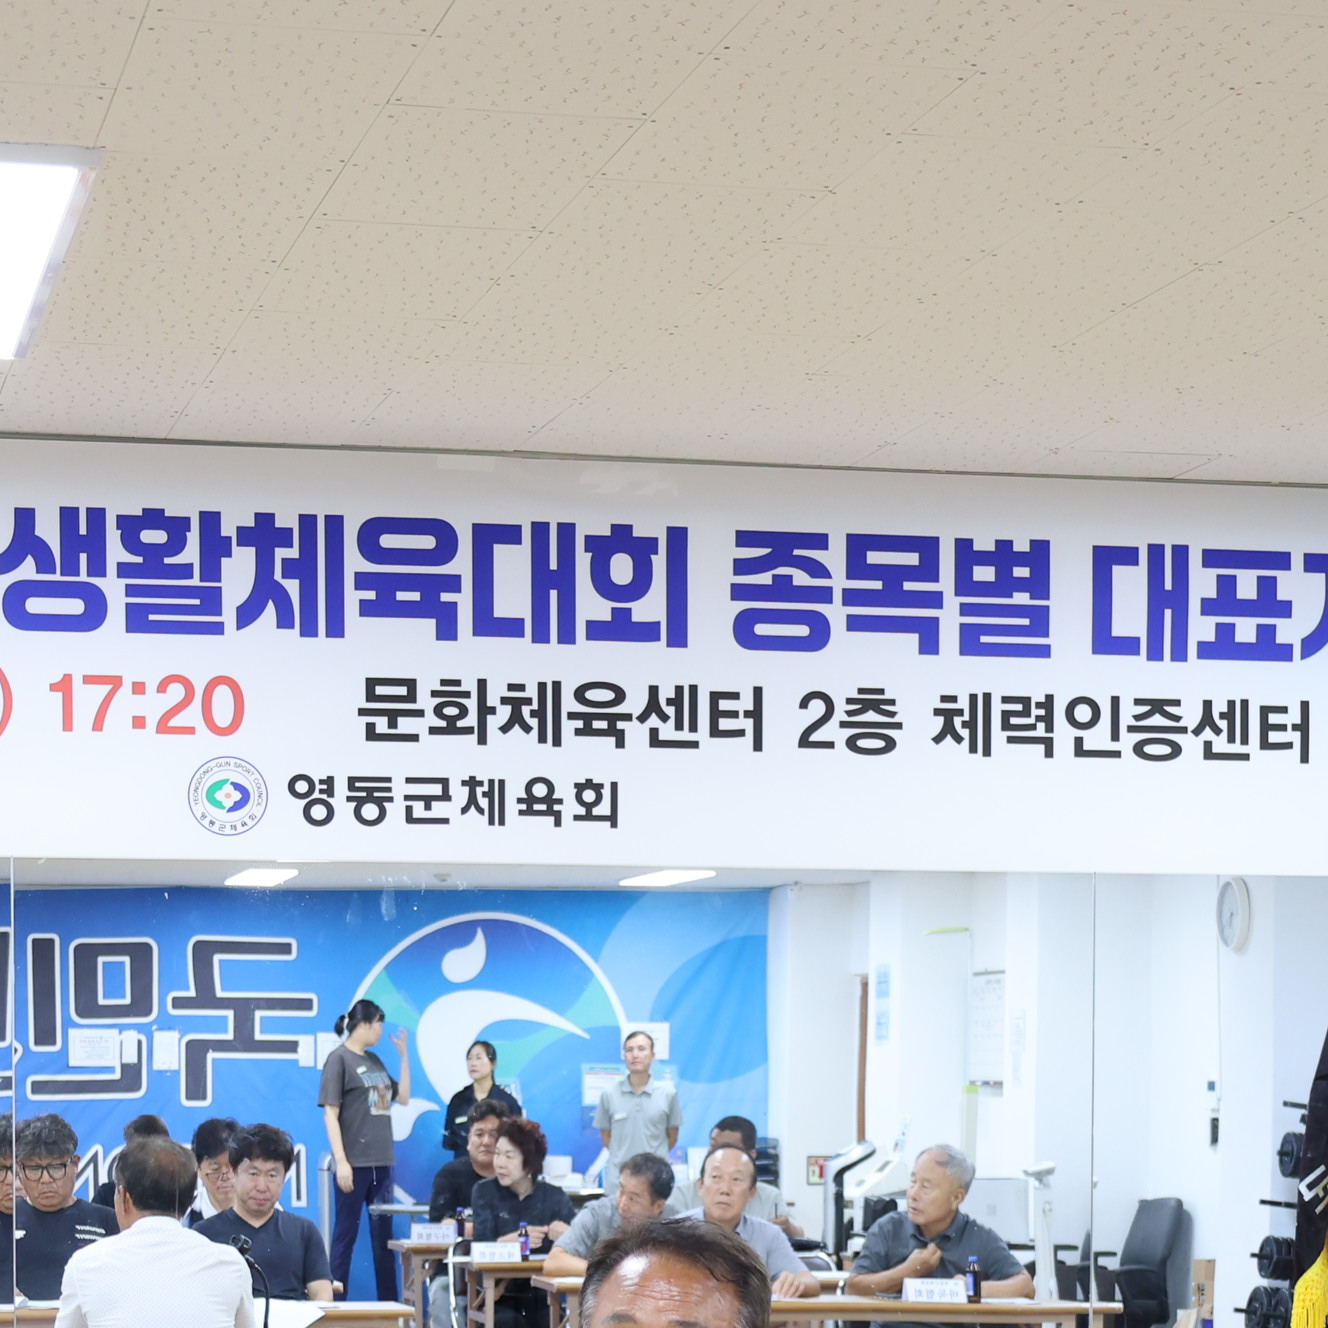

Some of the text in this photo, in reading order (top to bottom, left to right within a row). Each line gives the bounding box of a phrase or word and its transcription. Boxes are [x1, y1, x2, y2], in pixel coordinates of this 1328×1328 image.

[729, 528, 1052, 659] 종목별
[48, 672, 246, 737] 17:20
[356, 676, 764, 752] 문화체육센터
[798, 687, 904, 756] 2층
[931, 691, 1310, 765] 체력인증센터
[233, 762, 255, 777] SPORT
[287, 772, 619, 829] 영동군체육회
